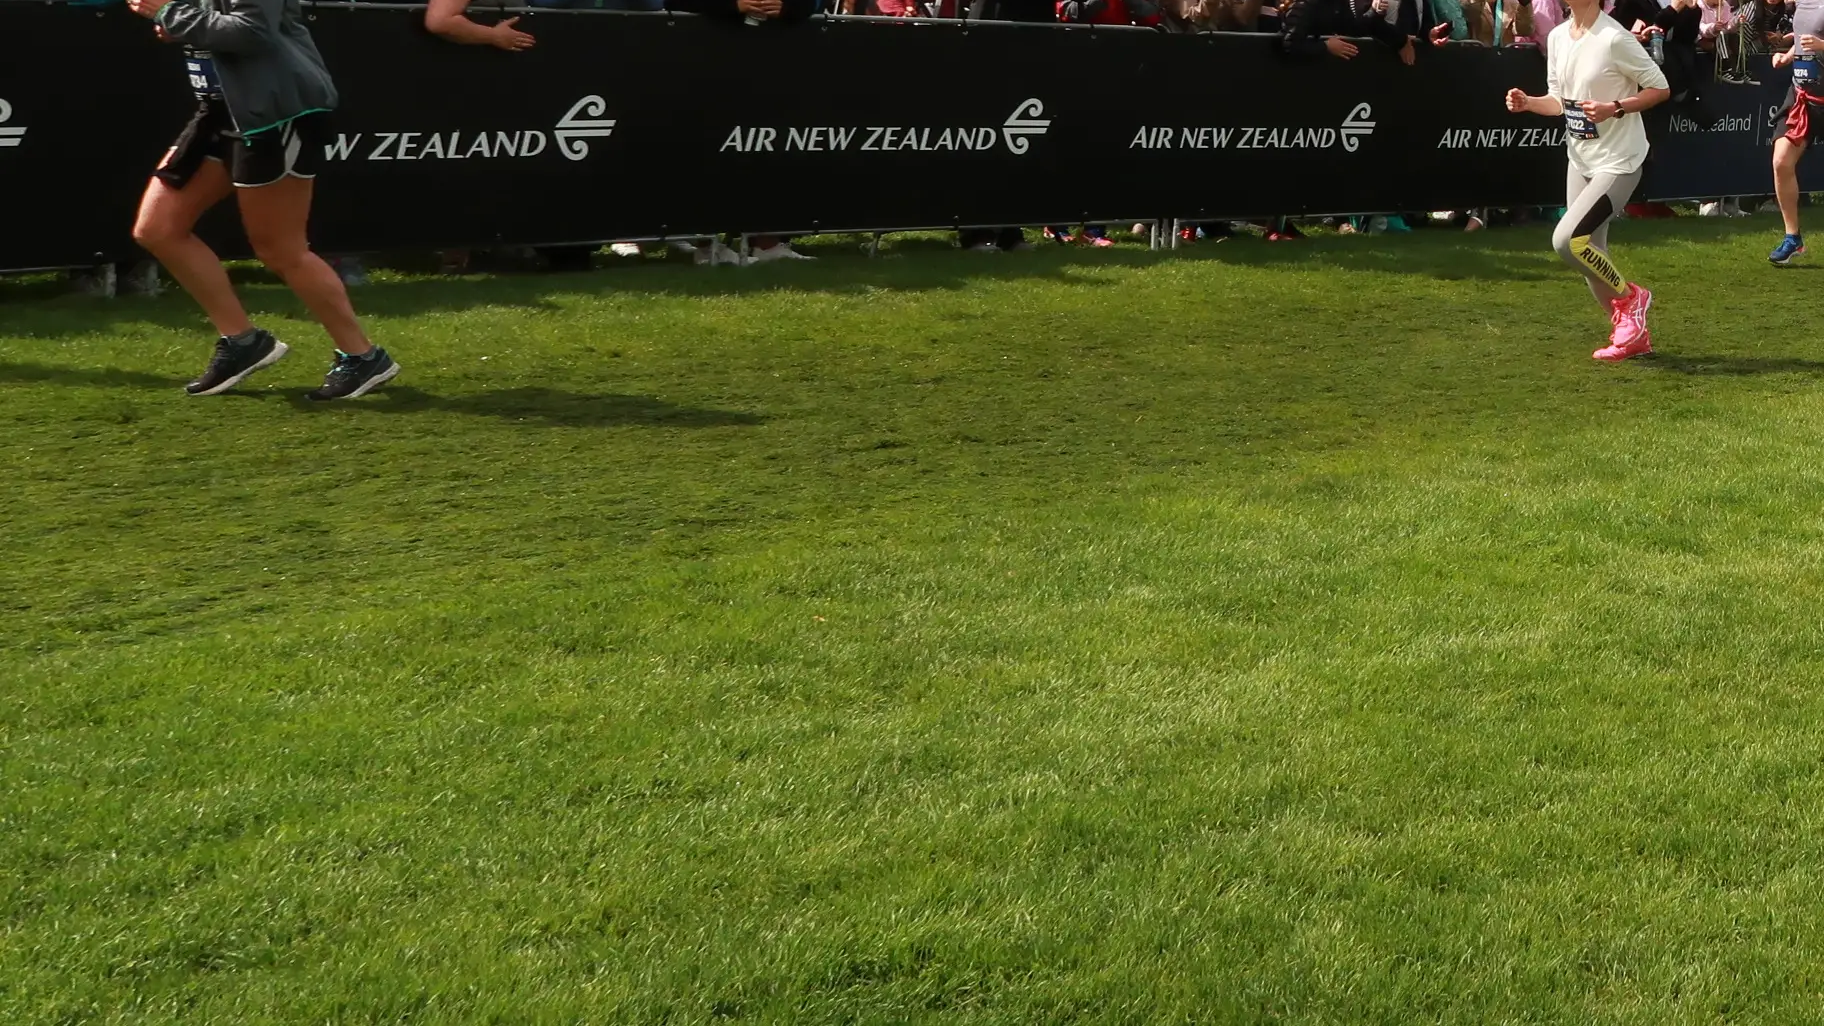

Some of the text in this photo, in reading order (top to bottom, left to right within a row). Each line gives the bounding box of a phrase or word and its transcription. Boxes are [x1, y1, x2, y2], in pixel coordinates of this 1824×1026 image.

[1669, 115, 1698, 133] New
[1701, 114, 1752, 132] ealand
[367, 130, 547, 160] ZEALAND
[719, 125, 997, 152] AIR NEW ZEALAND
[1129, 125, 1336, 149] AIR NEW ZEALAND
[1437, 128, 1568, 149] AIR NEW ZEALA
[1580, 247, 1621, 287] RUNNING
